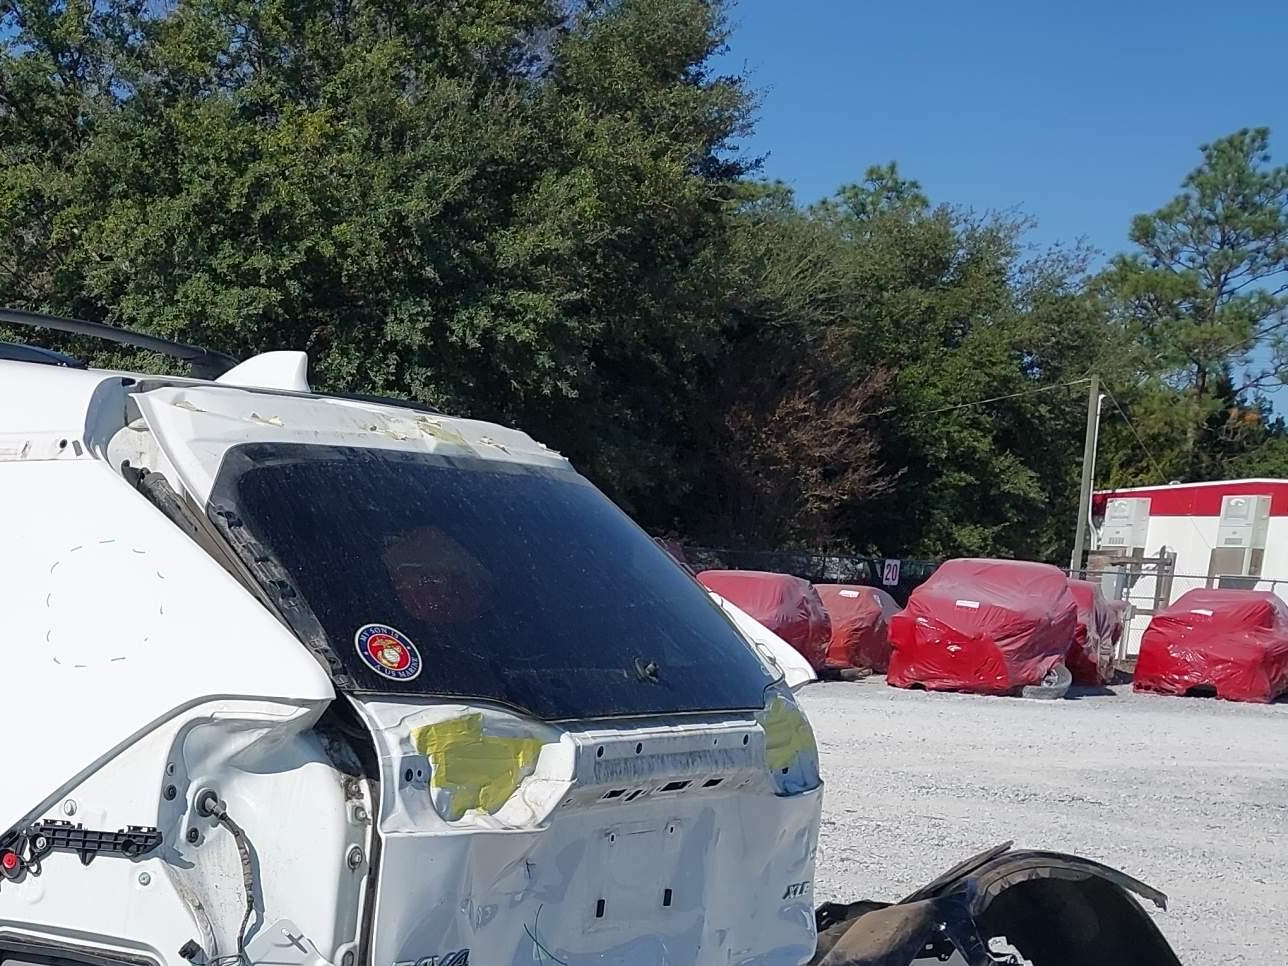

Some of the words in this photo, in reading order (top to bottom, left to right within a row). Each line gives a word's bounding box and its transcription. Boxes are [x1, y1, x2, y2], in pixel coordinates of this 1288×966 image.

[885, 563, 898, 581] 20
[384, 668, 397, 677] US
[398, 657, 418, 678] MARINE
